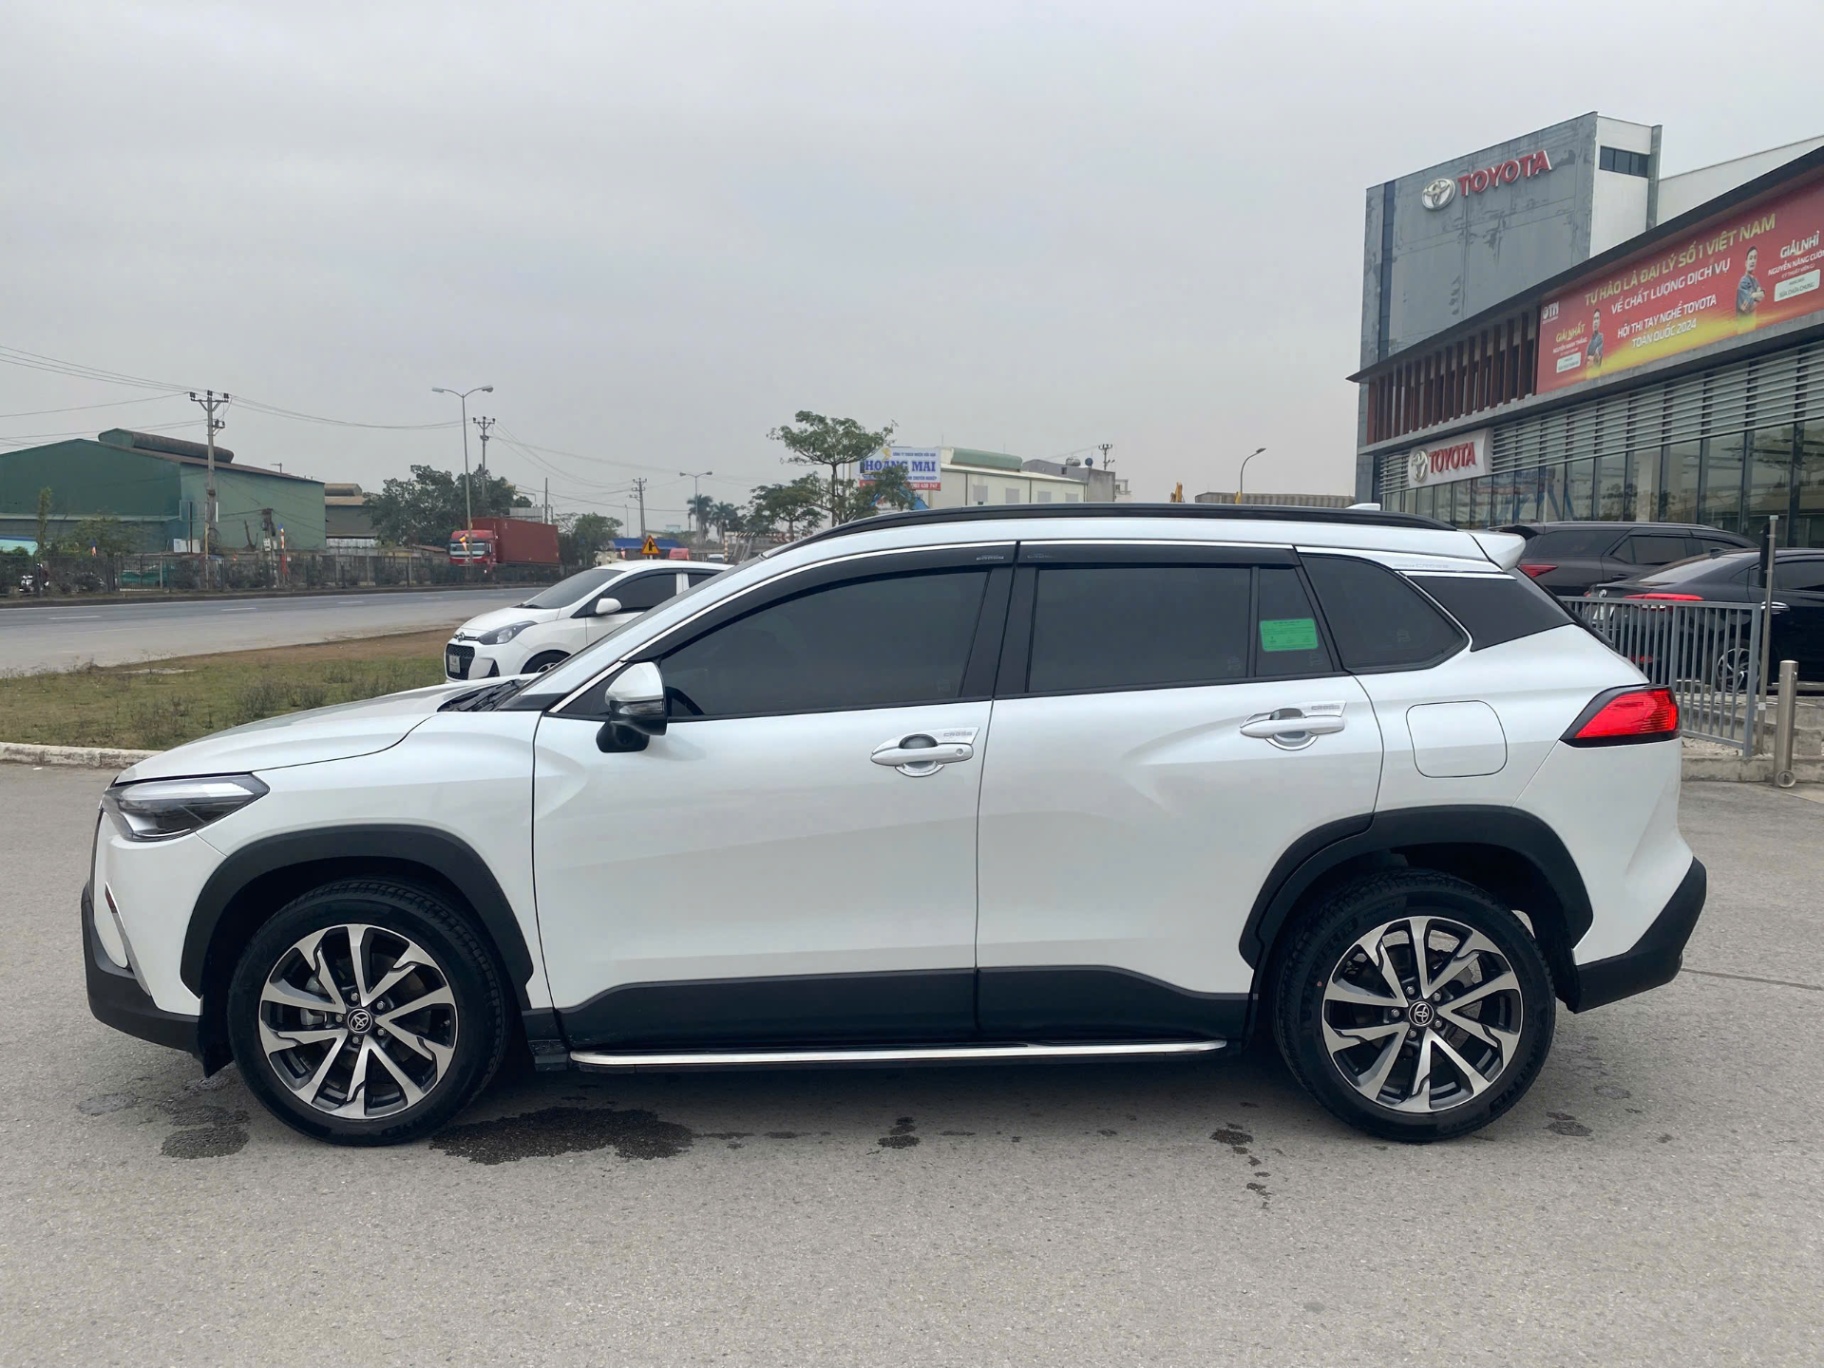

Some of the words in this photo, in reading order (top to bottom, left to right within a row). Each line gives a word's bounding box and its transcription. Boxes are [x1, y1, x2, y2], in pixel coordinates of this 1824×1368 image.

[1458, 150, 1552, 197] TOYOTA
[1585, 289, 1599, 306] TỰ
[1600, 281, 1621, 300] HÀO
[1624, 270, 1638, 290] LÀ
[1641, 264, 1660, 283] ĐẠI
[1662, 253, 1676, 274] LÝ
[1678, 241, 1697, 267] SỐ
[1706, 230, 1737, 255] VIỆT
[1739, 213, 1776, 242] NAM
[1624, 287, 1649, 309] CHẤT
[1650, 276, 1686, 299] LƯỢNG
[1687, 264, 1713, 285] DỊCH
[1714, 257, 1731, 274] VỤ
[1631, 320, 1644, 333] THI
[1644, 314, 1660, 329] TAY
[1683, 294, 1717, 314] TOYOTA
[1653, 322, 1677, 341] QUỐC
[1676, 318, 1697, 334] 2024
[912, 461, 936, 472] MAI
[1429, 442, 1476, 473] TOYOTA
